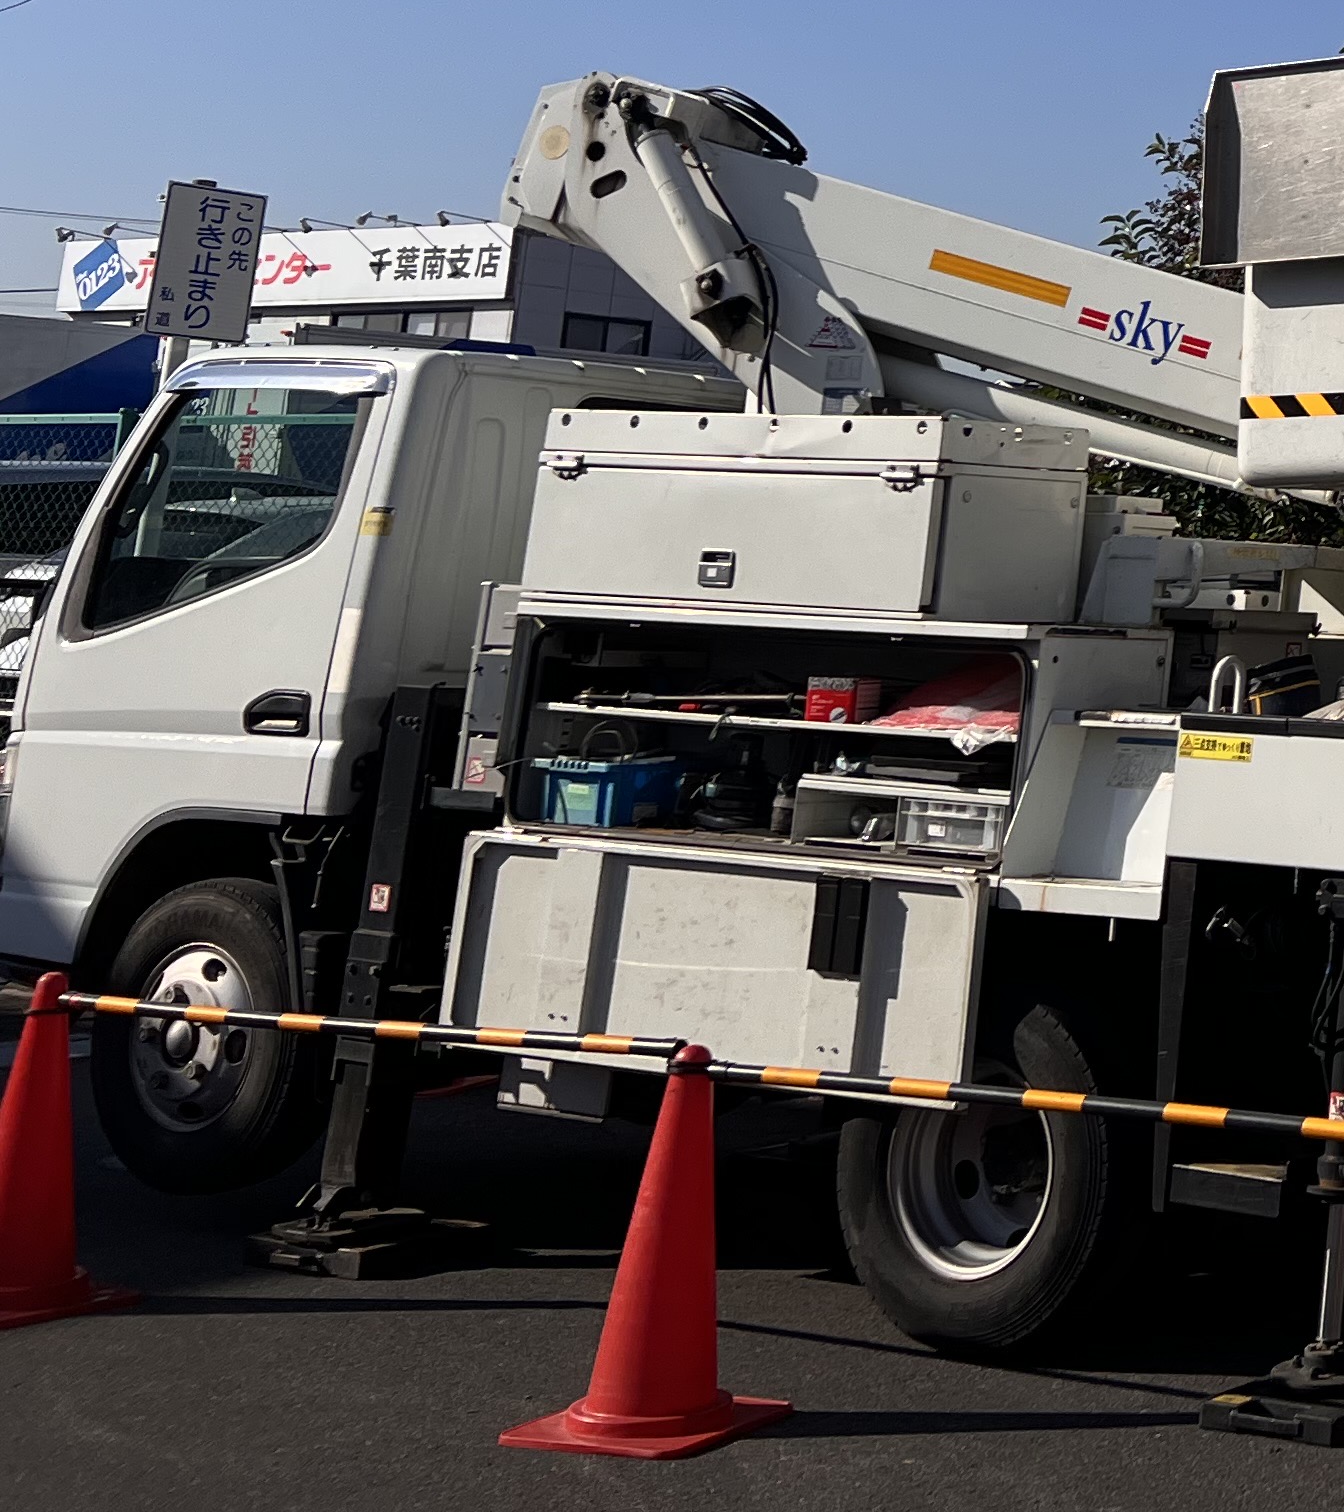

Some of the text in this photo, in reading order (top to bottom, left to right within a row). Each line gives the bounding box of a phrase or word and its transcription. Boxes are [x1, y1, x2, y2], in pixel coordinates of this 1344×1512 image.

[184, 196, 231, 329] 行き止まり
[226, 202, 255, 272] この先
[368, 243, 502, 282] 千葉南支店
[77, 252, 122, 301] 0123
[154, 286, 175, 327] 私道
[1108, 300, 1186, 365] sky
